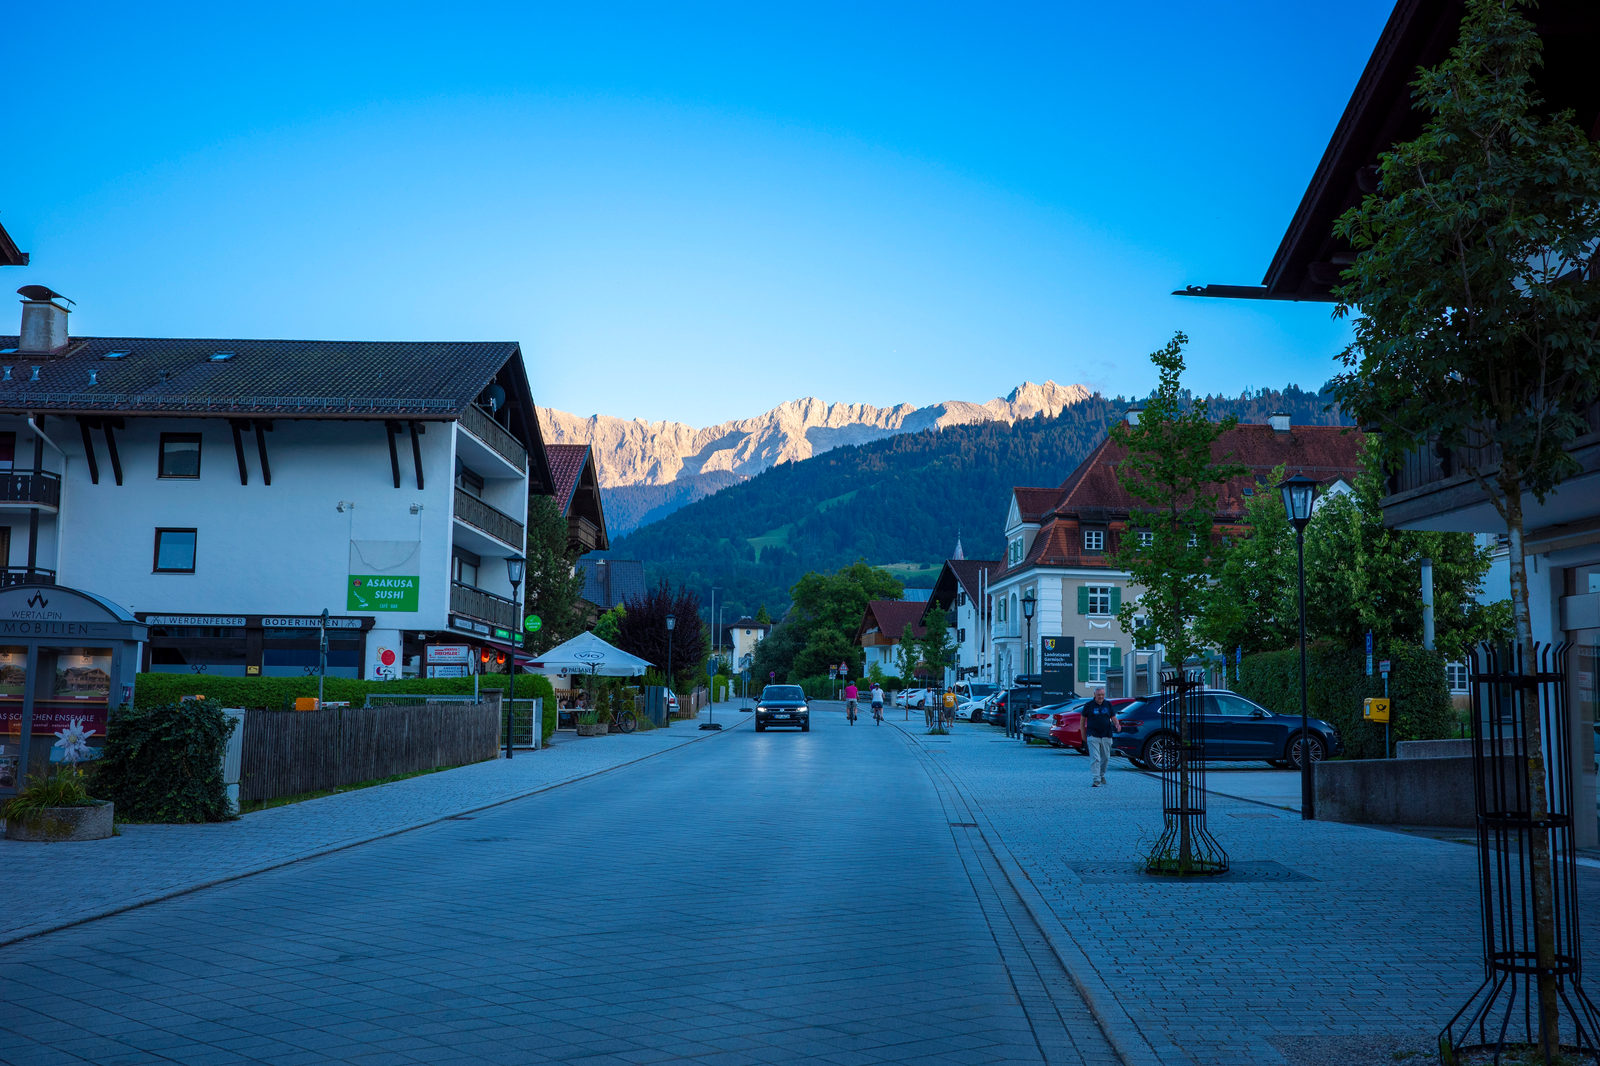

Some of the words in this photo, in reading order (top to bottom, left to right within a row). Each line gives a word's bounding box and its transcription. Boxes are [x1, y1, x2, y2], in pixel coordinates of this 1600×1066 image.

[367, 578, 413, 588] ASAKUSA
[375, 590, 404, 600] SUSHI
[12, 610, 62, 620] WERTALPIN
[169, 617, 243, 625] WERDENFELSER
[3, 622, 89, 635] MOBILIEN
[54, 714, 95, 722] ENSEMBLE
